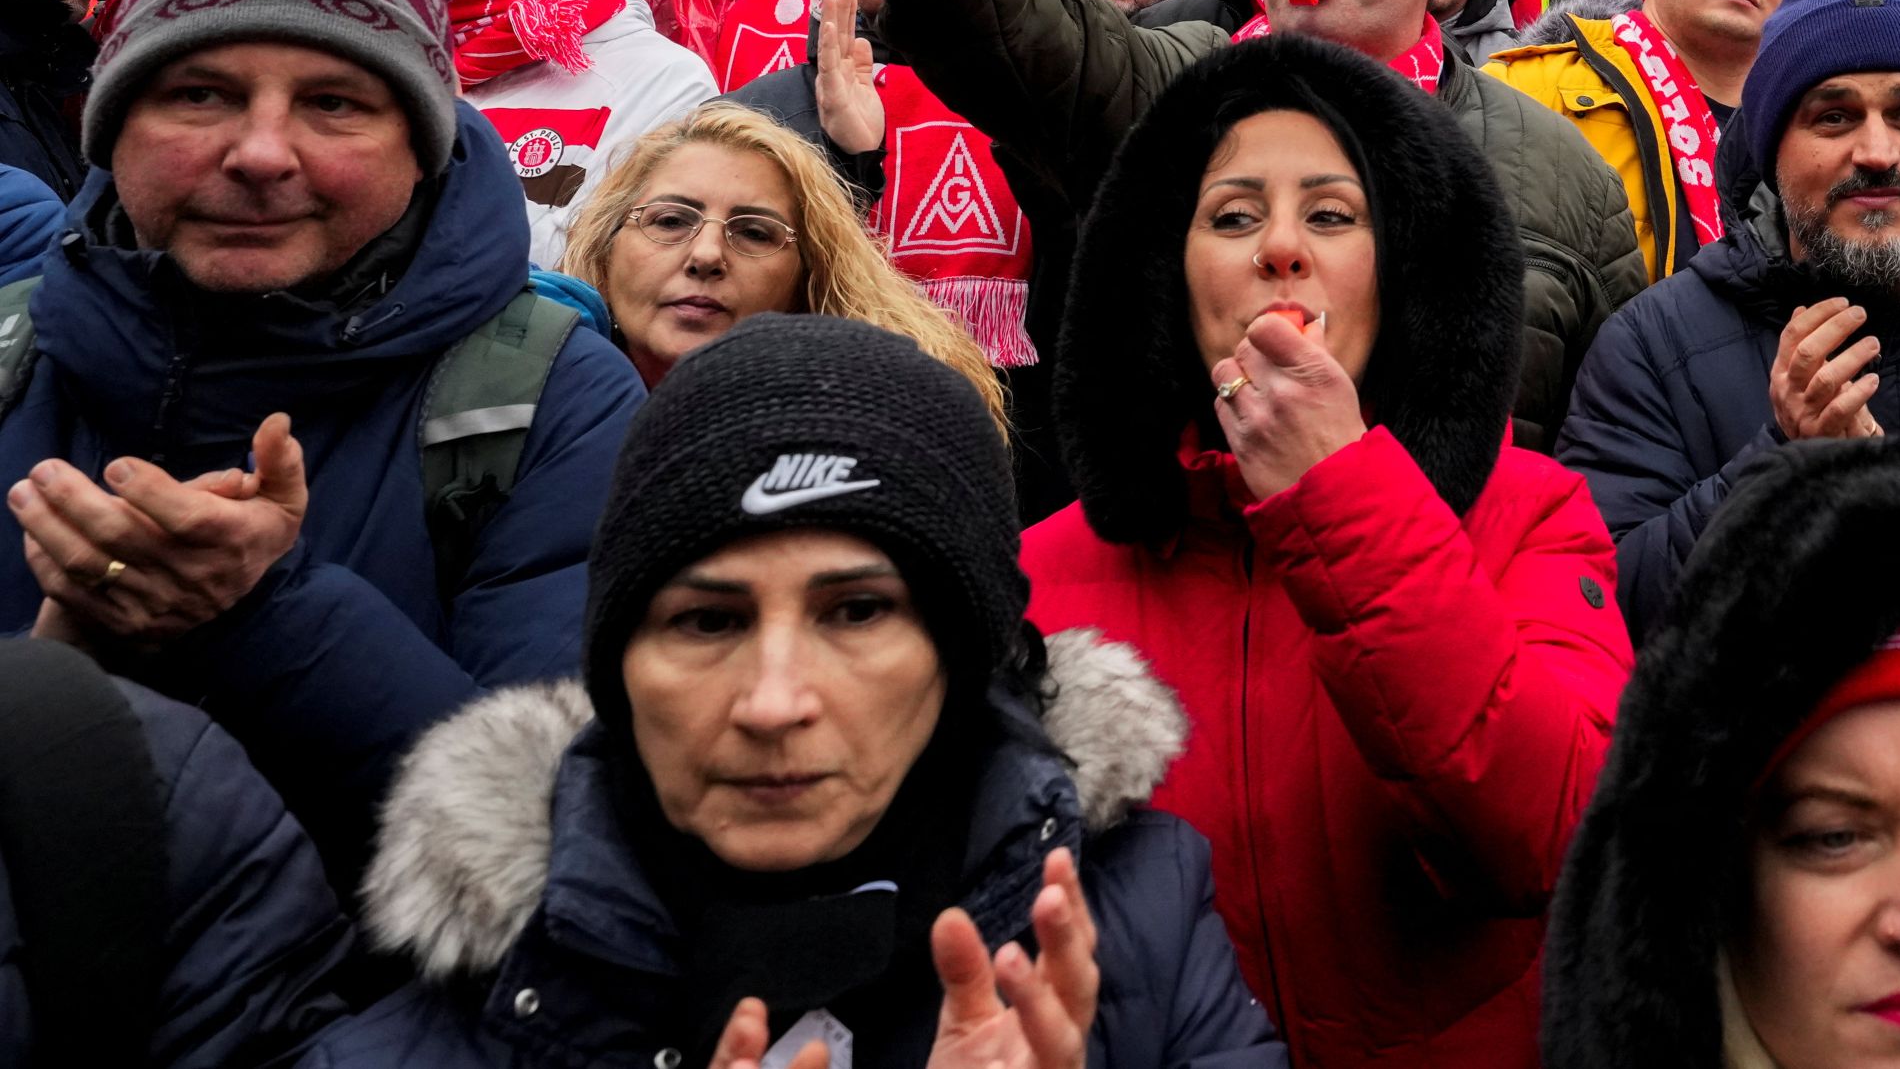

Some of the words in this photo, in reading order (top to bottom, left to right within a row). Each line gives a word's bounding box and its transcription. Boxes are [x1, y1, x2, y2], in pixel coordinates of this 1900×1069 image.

[512, 142, 523, 153] FC
[540, 130, 561, 151] PAULI
[520, 167, 541, 177] 1910
[763, 454, 858, 490] NIKE
